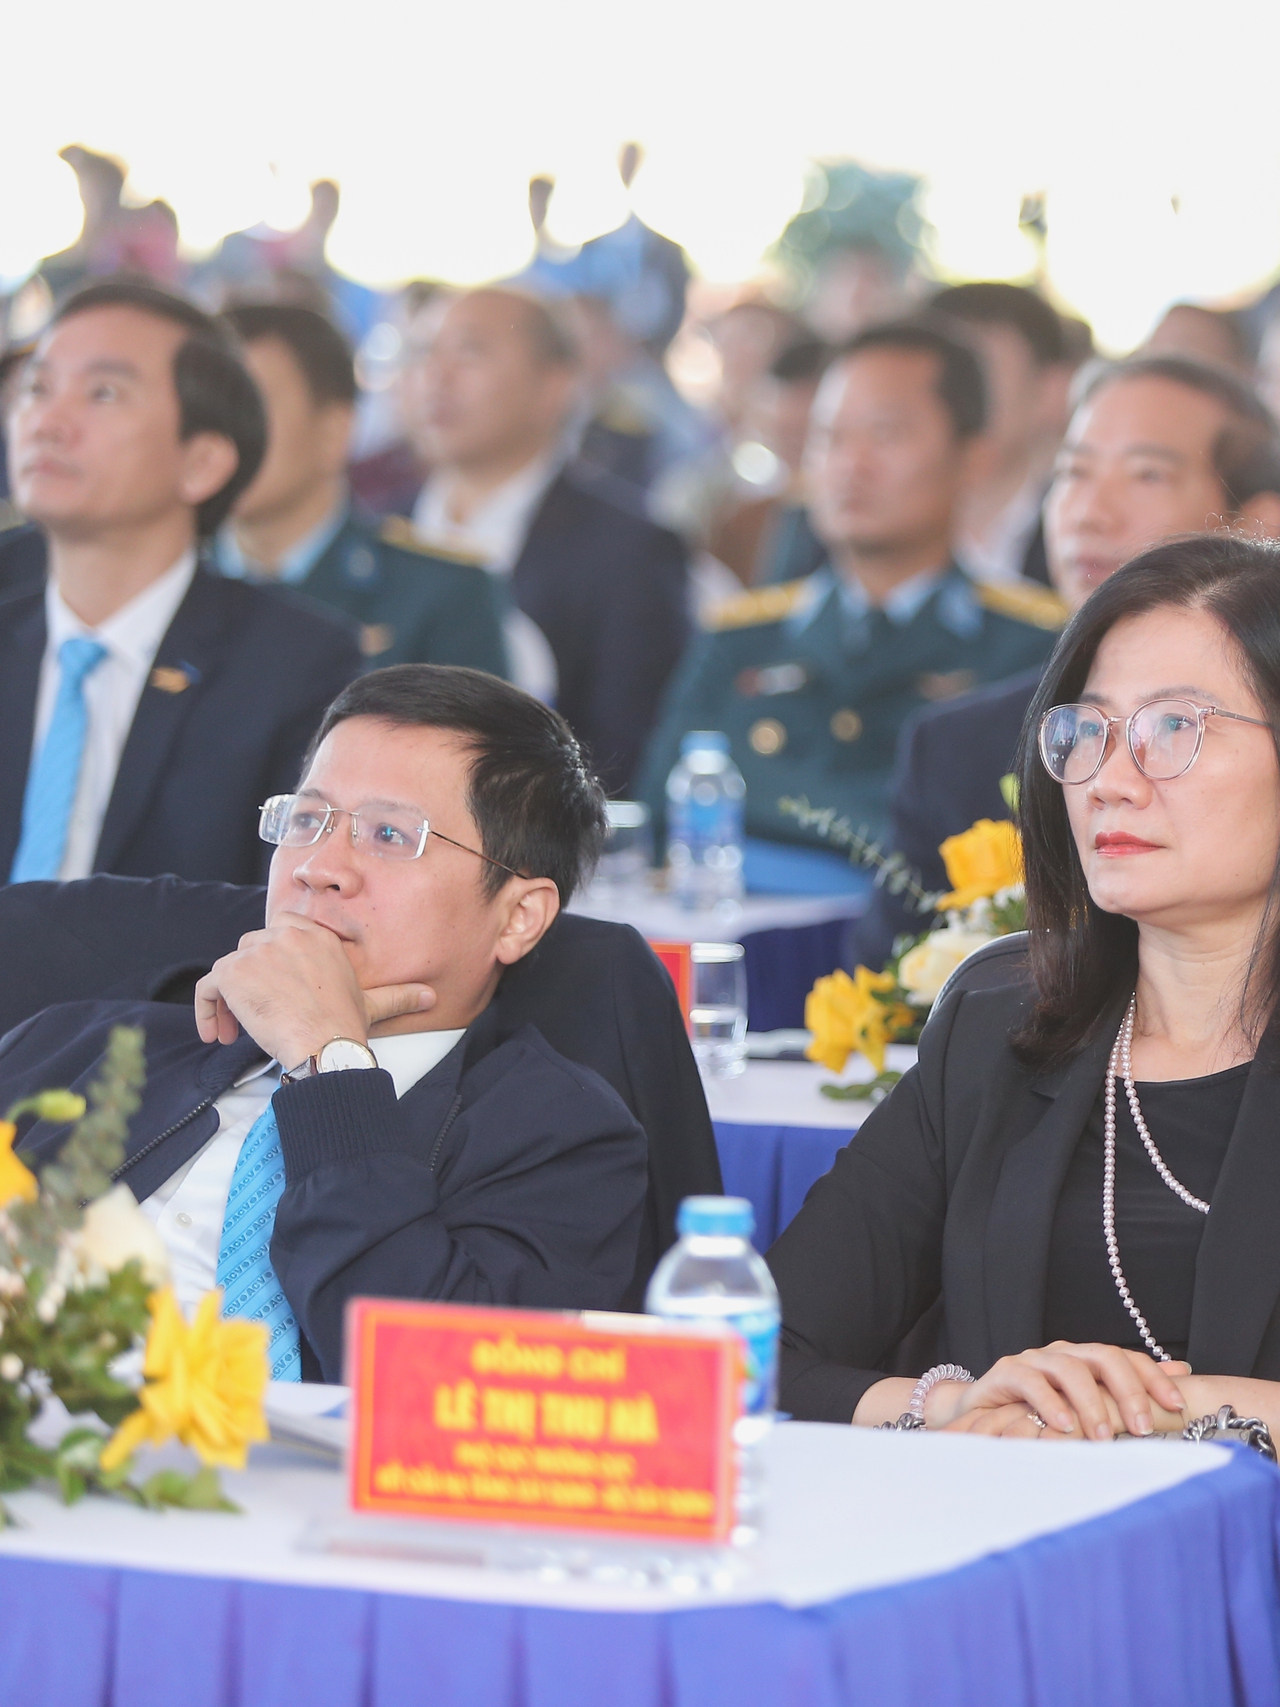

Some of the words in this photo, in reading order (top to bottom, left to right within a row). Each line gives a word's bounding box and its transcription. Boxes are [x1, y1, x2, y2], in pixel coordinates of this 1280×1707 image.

[238, 1170, 255, 1188] ACV
[261, 1146, 280, 1163] ACV
[232, 1201, 251, 1221] ACV
[256, 1179, 275, 1197] ACV
[228, 1232, 247, 1253] ACV
[252, 1210, 272, 1230] ACV
[225, 1266, 243, 1286] ACV
[250, 1243, 269, 1262] ACV
[247, 1275, 266, 1297] ACV
[483, 1388, 536, 1441] THỊ
